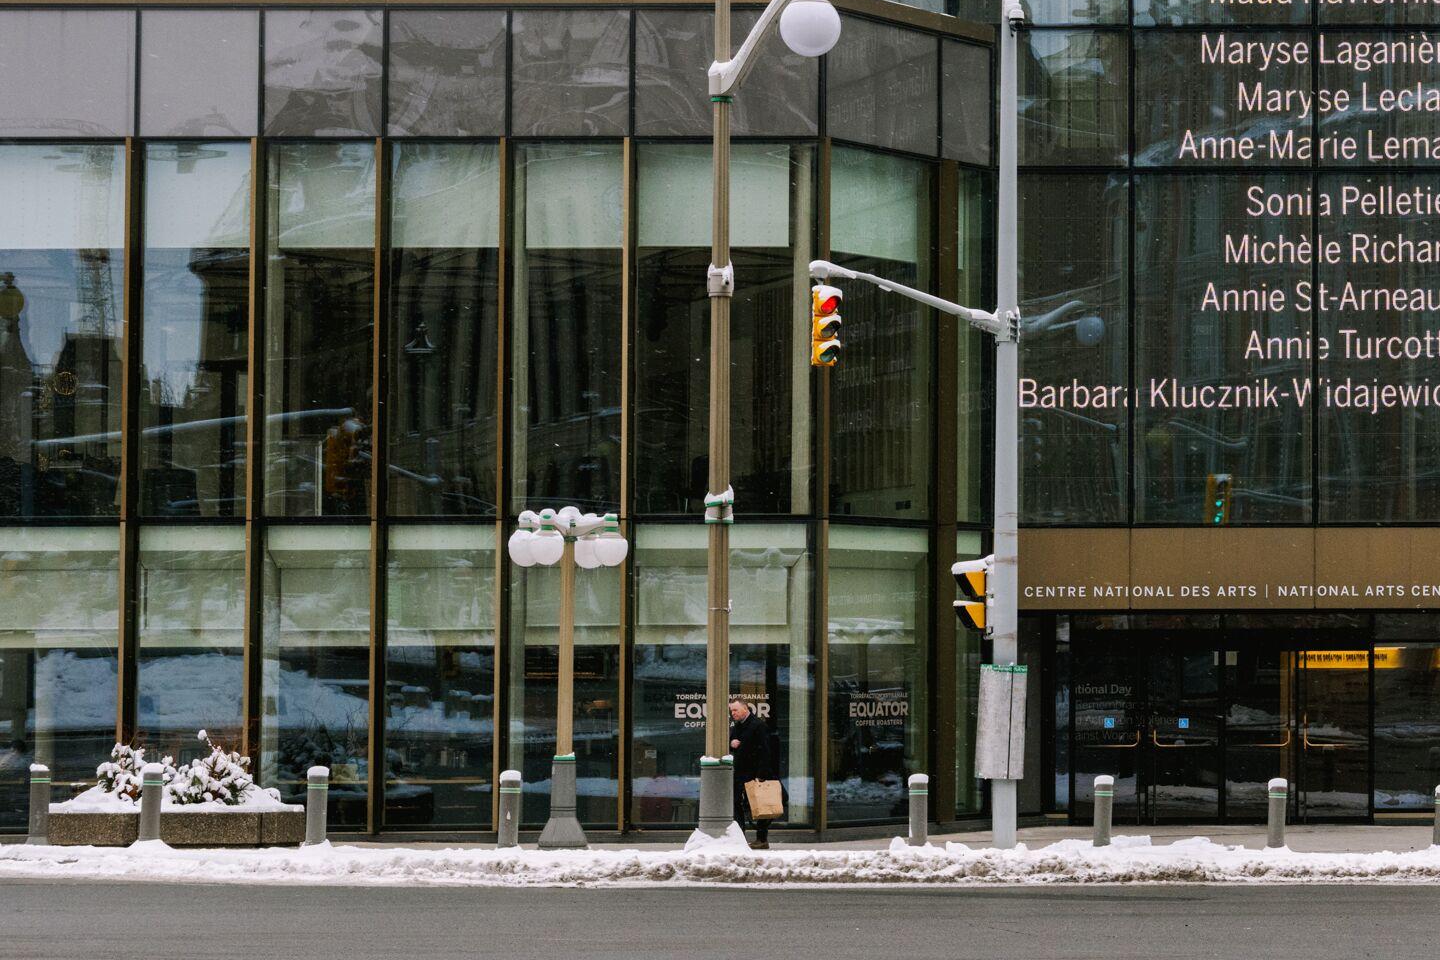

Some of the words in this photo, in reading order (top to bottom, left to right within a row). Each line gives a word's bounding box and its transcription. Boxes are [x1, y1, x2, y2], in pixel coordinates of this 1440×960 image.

[1201, 34, 1309, 71] Maryse
[1238, 82, 1350, 119] Maryse
[1179, 129, 1358, 160] Anne-Marie
[1246, 186, 1331, 217] Sonia
[1225, 234, 1341, 264] Michèle
[1201, 282, 1285, 312] Annie
[1244, 330, 1329, 360] Annie
[1018, 378, 1139, 409] Barbara
[1024, 586, 1087, 597] CENTRE
[1093, 585, 1175, 597] NATIONAL
[1180, 585, 1211, 597] DES
[1216, 585, 1257, 597] ARTS
[1278, 585, 1359, 597] NATIONAL
[1365, 585, 1405, 597] ARTS
[676, 692, 707, 700] TORRÉFA
[849, 701, 909, 717] EQUATOR
